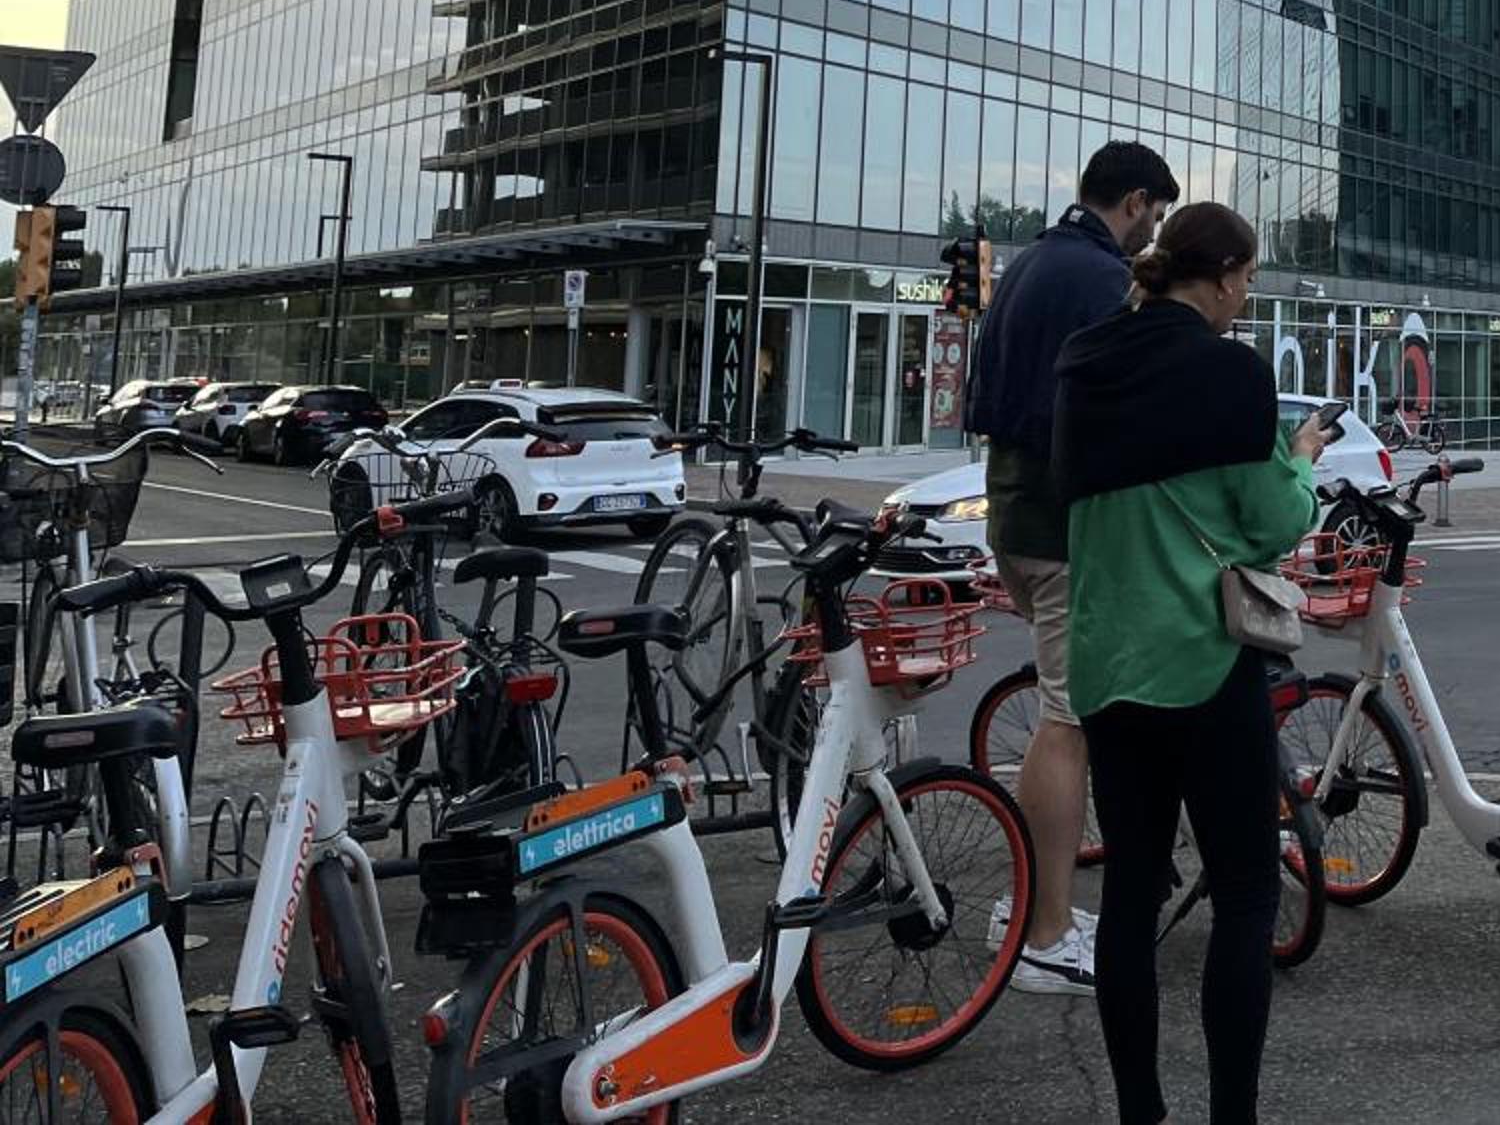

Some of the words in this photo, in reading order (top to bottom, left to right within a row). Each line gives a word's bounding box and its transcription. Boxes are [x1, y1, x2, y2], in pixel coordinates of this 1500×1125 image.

[1396, 672, 1430, 732] movi
[552, 811, 636, 857] elettrica
[273, 797, 319, 975] ridemovi
[45, 916, 116, 976] electric
